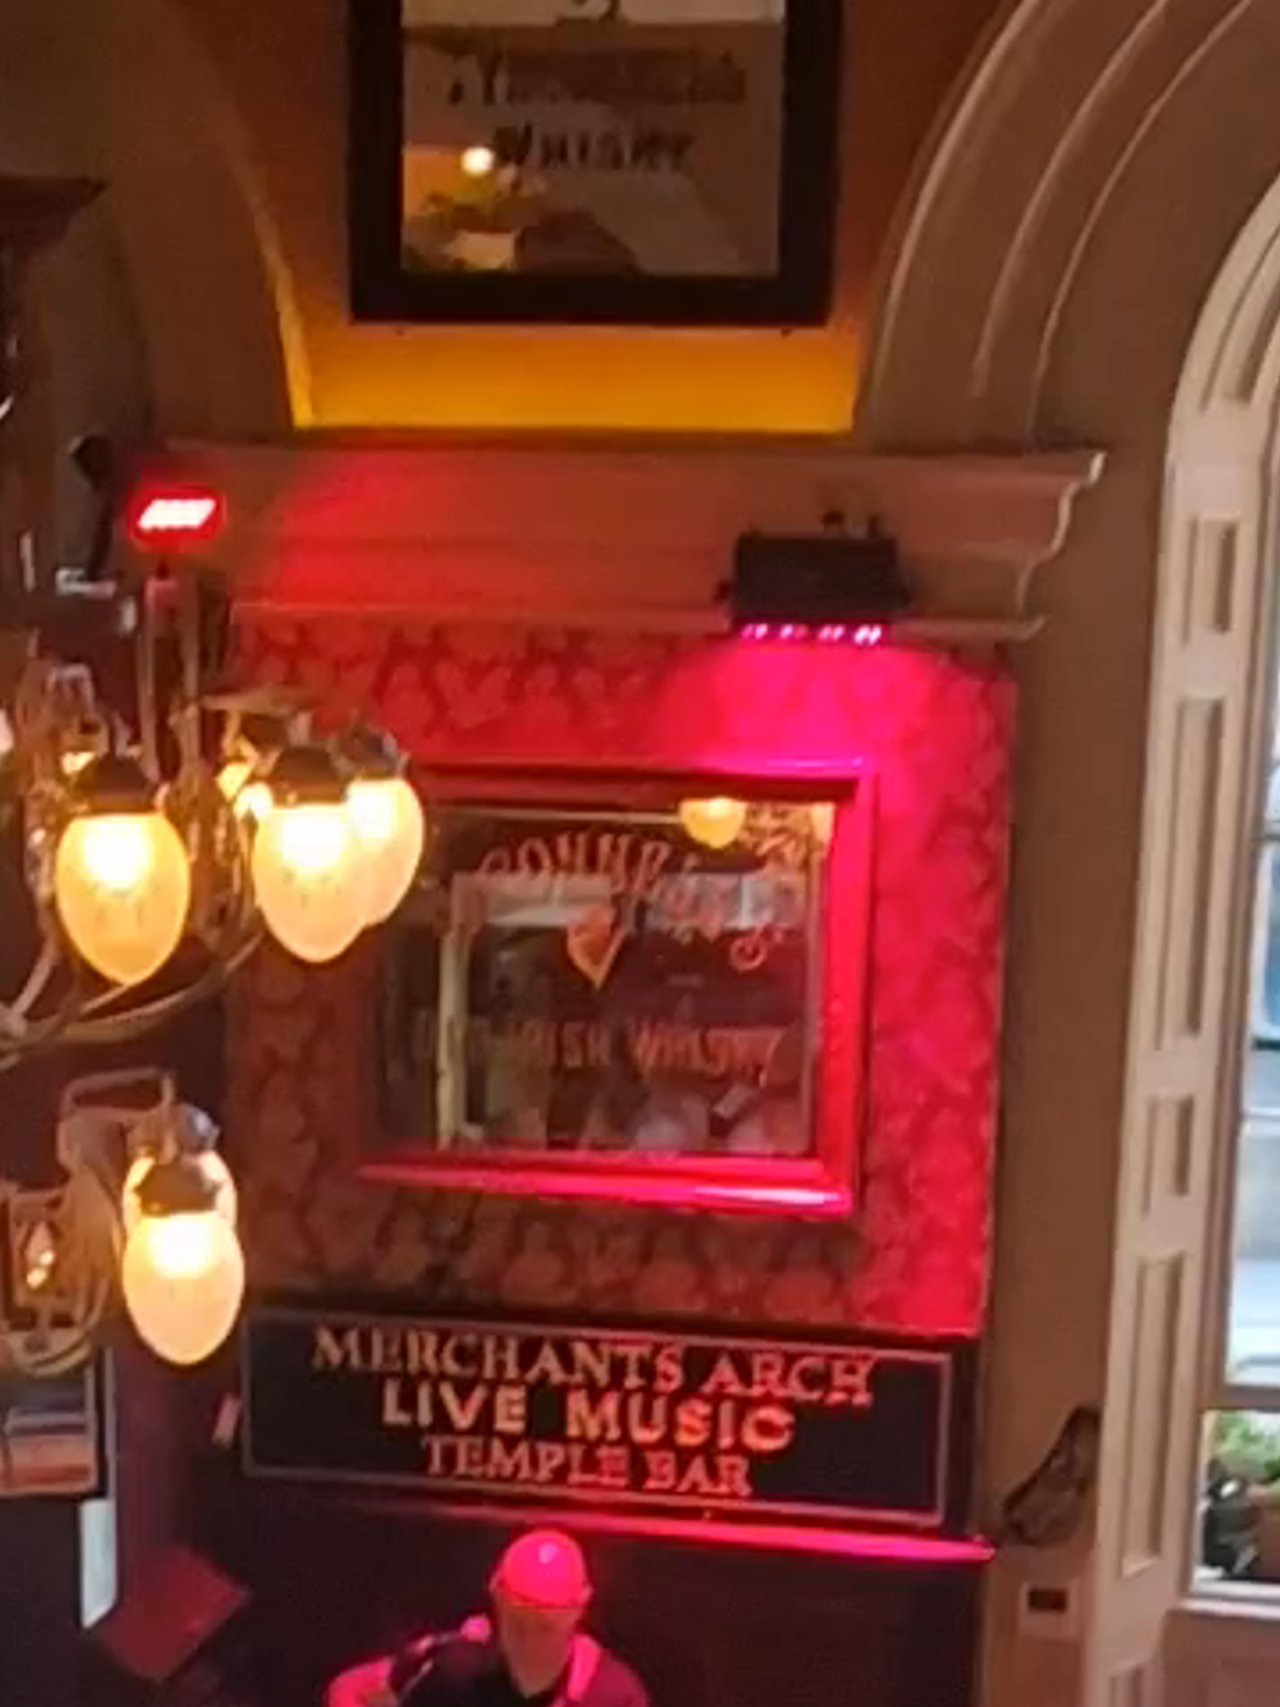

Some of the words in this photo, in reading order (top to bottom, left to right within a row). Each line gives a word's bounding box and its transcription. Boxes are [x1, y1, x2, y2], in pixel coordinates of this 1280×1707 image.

[313, 1326, 685, 1393] MERCHANTS
[700, 1351, 881, 1407] ARCH
[382, 1377, 526, 1434] LIVE
[566, 1387, 796, 1451] MUSIC
[422, 1433, 628, 1486] TEMPLE
[643, 1448, 752, 1497] BAR
